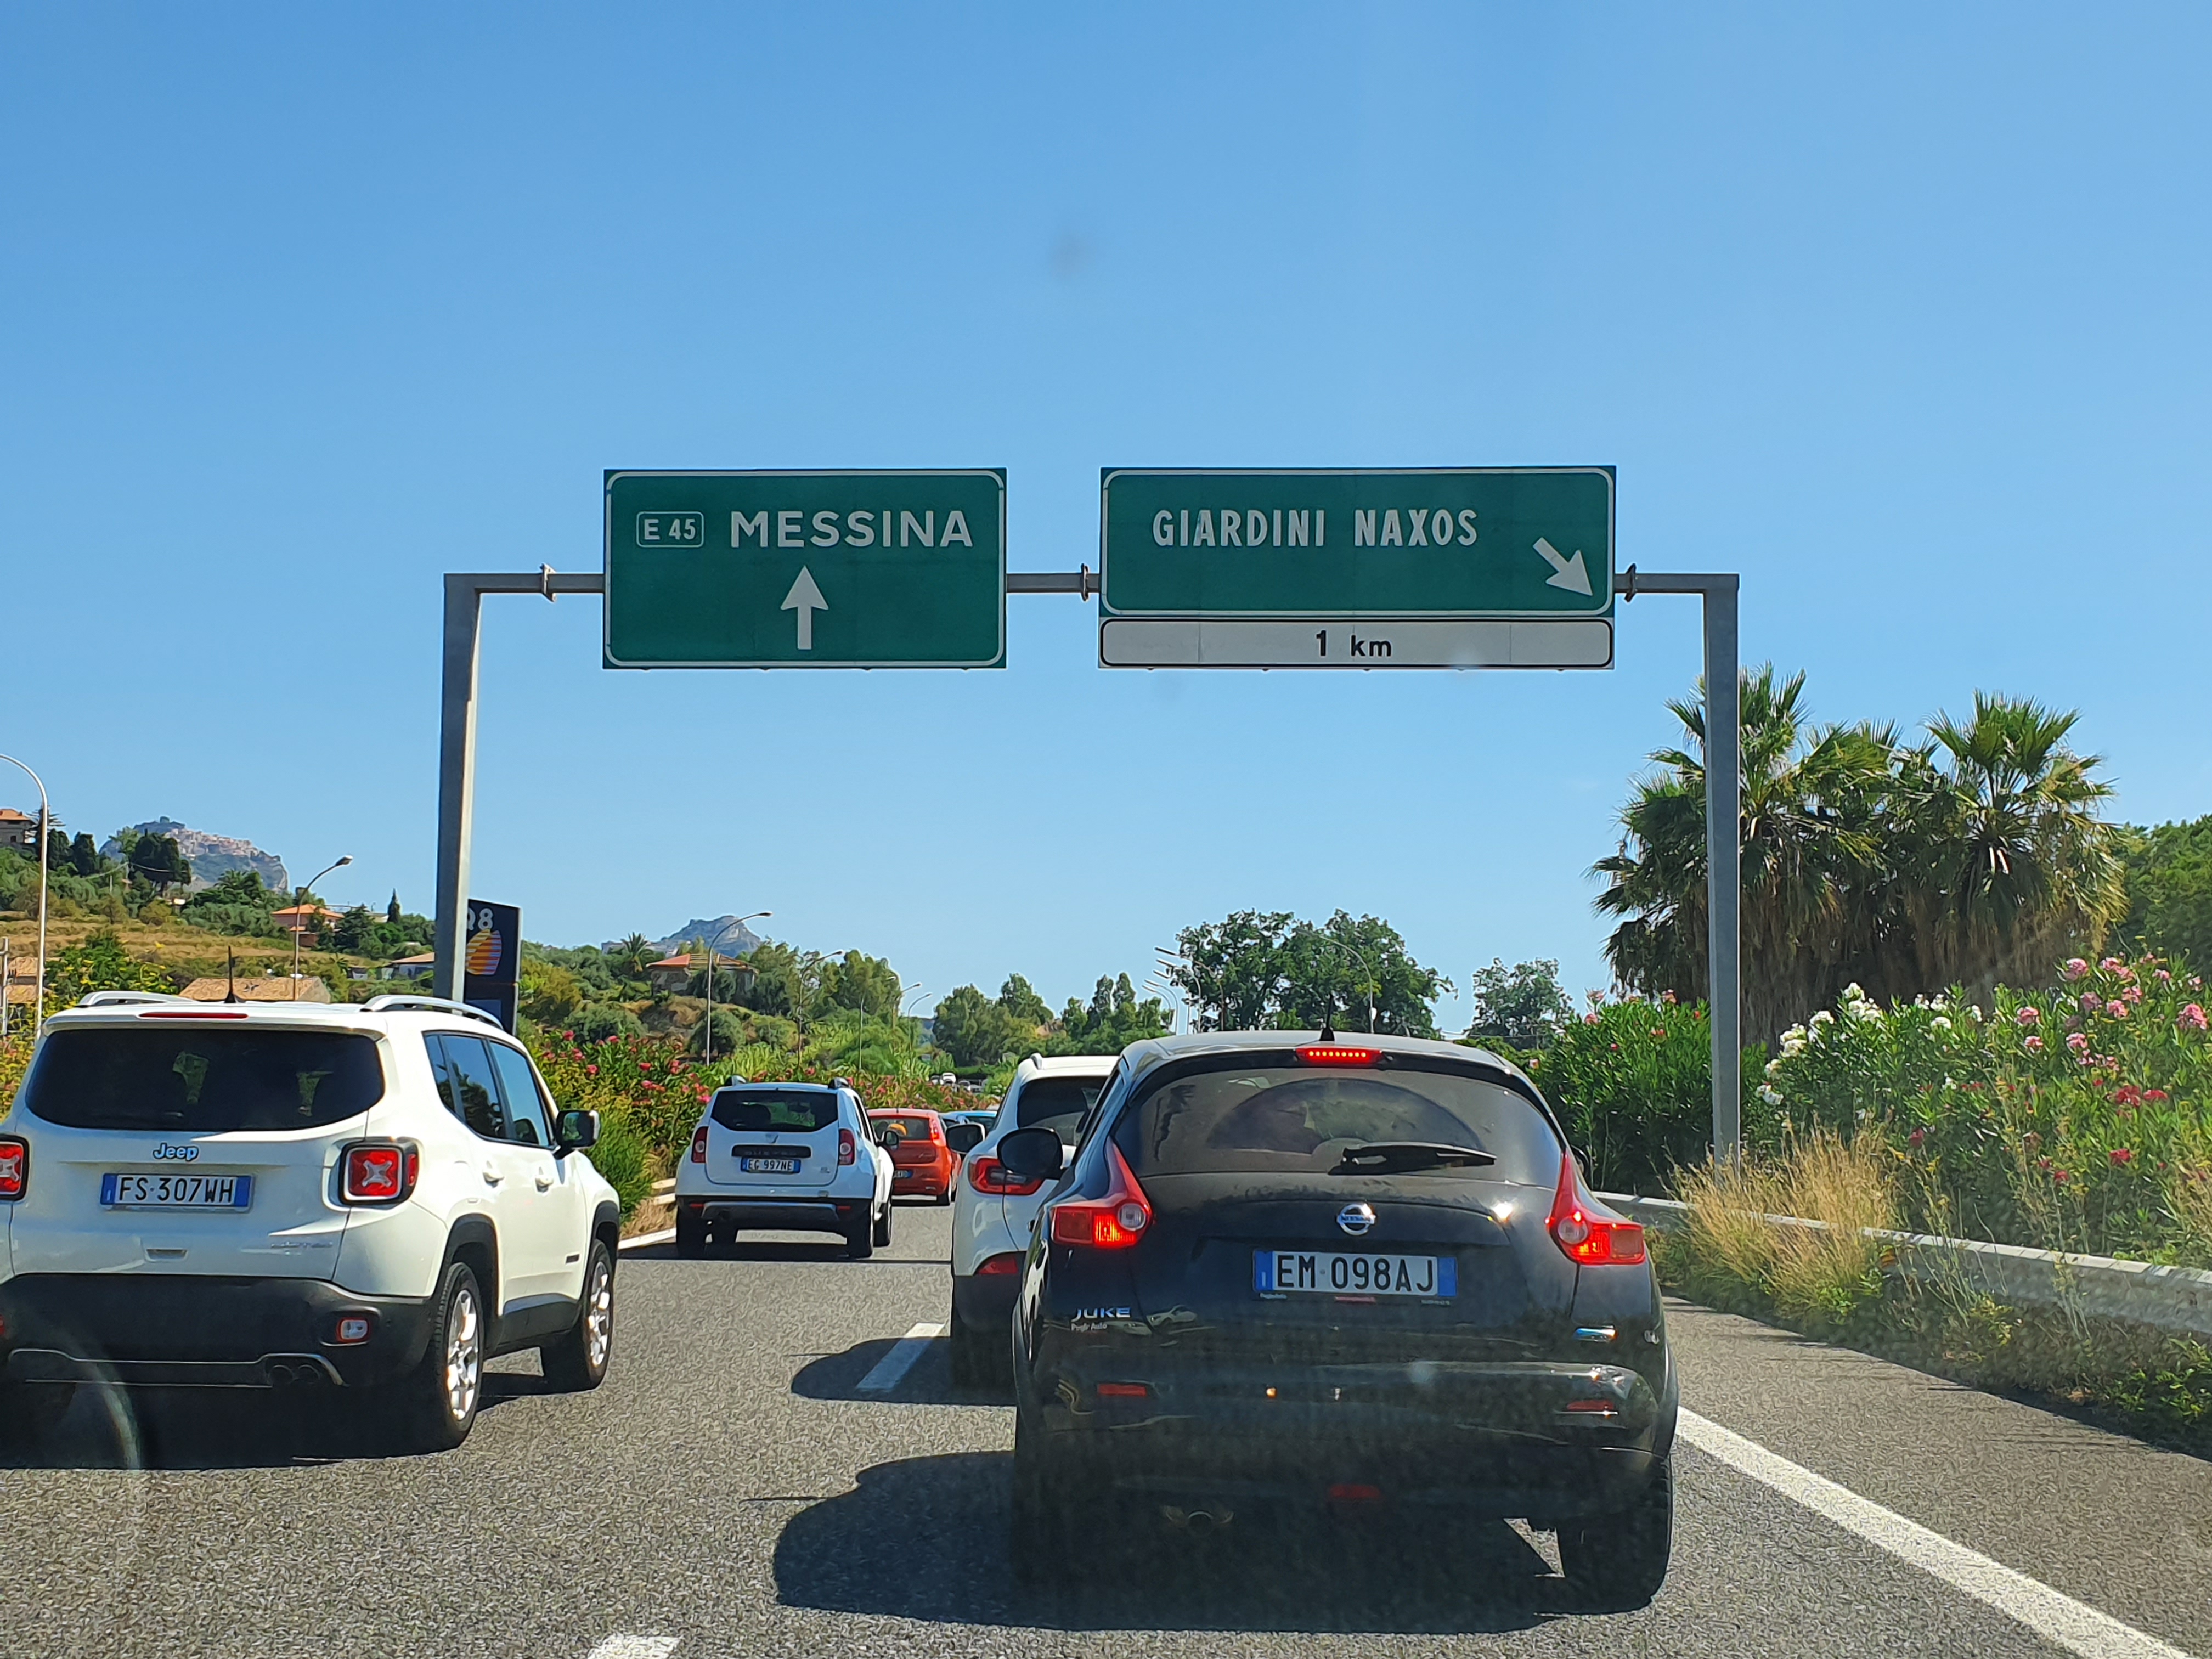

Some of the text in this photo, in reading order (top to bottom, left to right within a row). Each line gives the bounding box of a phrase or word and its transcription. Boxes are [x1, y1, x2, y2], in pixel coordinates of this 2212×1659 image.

[643, 518, 696, 540] E 45
[730, 510, 973, 548] MESSINA
[1152, 509, 1478, 547] GIARDINI NAXOS
[1316, 629, 1392, 657] 1 km
[153, 1143, 199, 1161] Jeep
[119, 1177, 149, 1201] FS
[157, 1177, 234, 1203] 307WH
[1277, 1254, 1316, 1288] EM
[1331, 1256, 1434, 1292] 098AJ
[1070, 1307, 1131, 1323] JUKE
